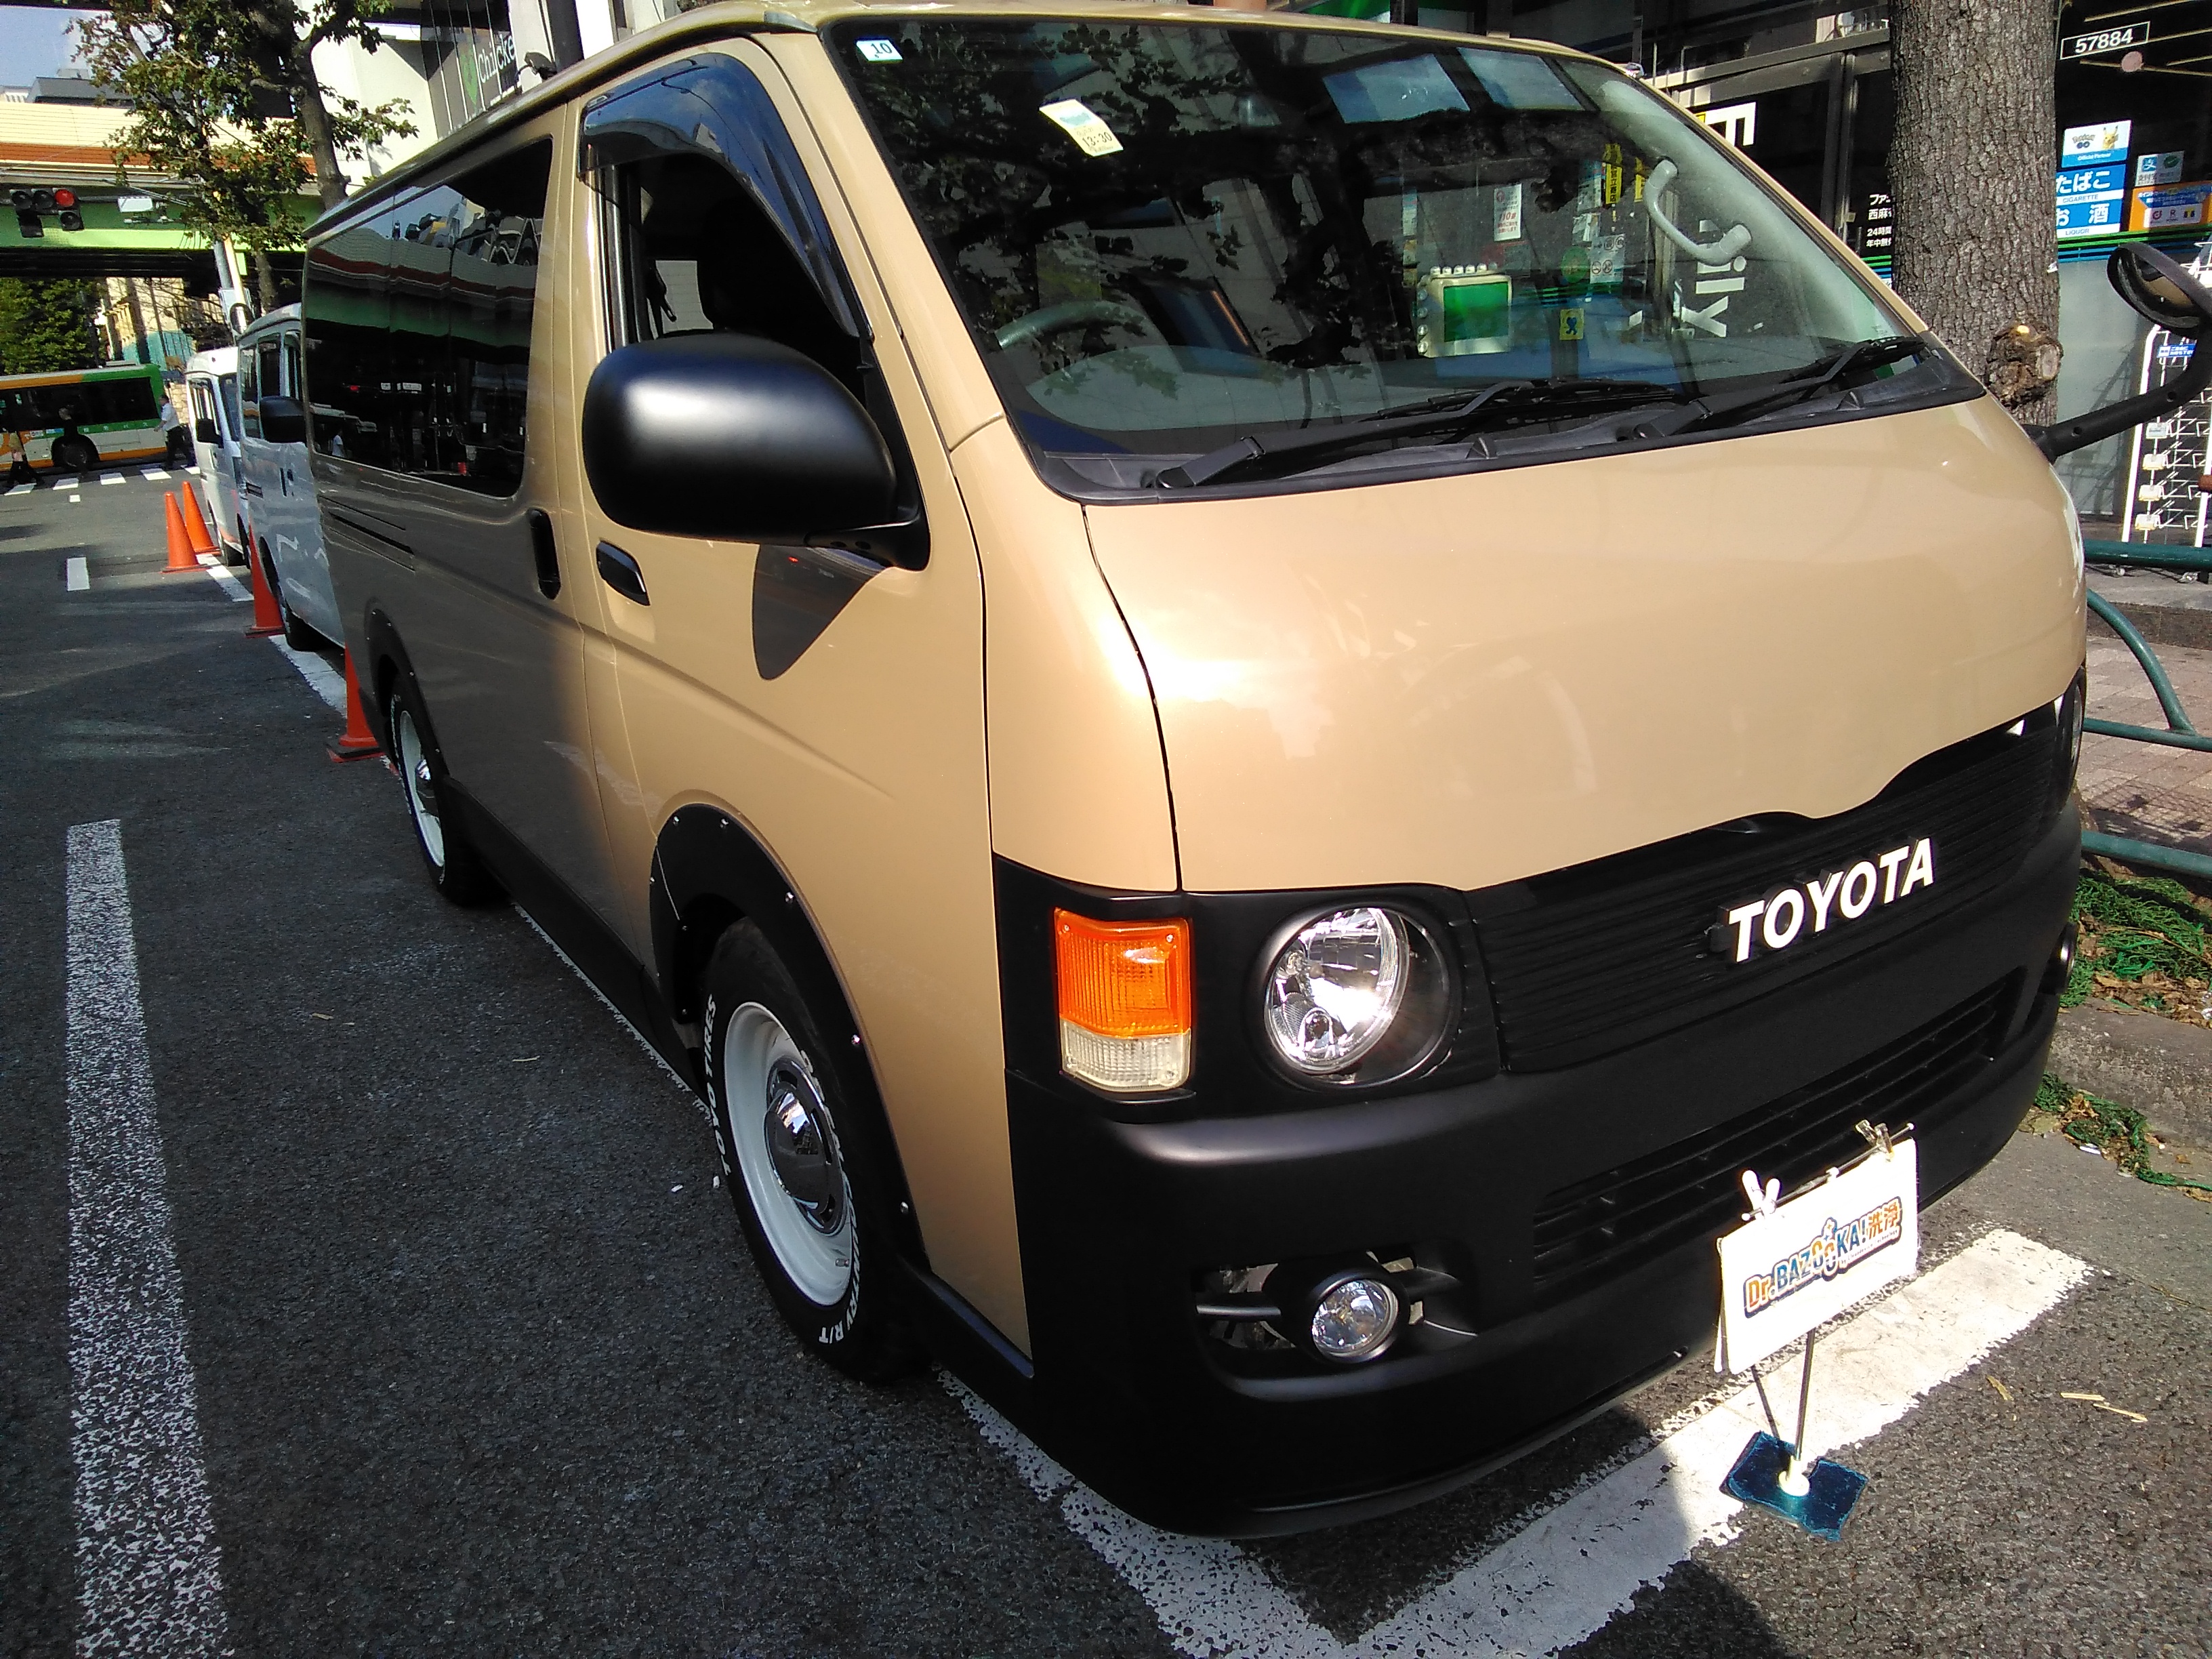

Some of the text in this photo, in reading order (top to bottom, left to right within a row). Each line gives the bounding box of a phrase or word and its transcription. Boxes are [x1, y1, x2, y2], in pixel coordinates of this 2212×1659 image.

[870, 43, 893, 54] 10
[2074, 28, 2133, 54] 57884
[1082, 131, 1112, 147] 13:30
[2056, 171, 2110, 194] たばこ
[2062, 194, 2099, 203] CIGARETTE
[1728, 837, 1935, 963] TOYOTA
[704, 994, 731, 1176] TOYO TIRES
[818, 1320, 844, 1345] R/T
